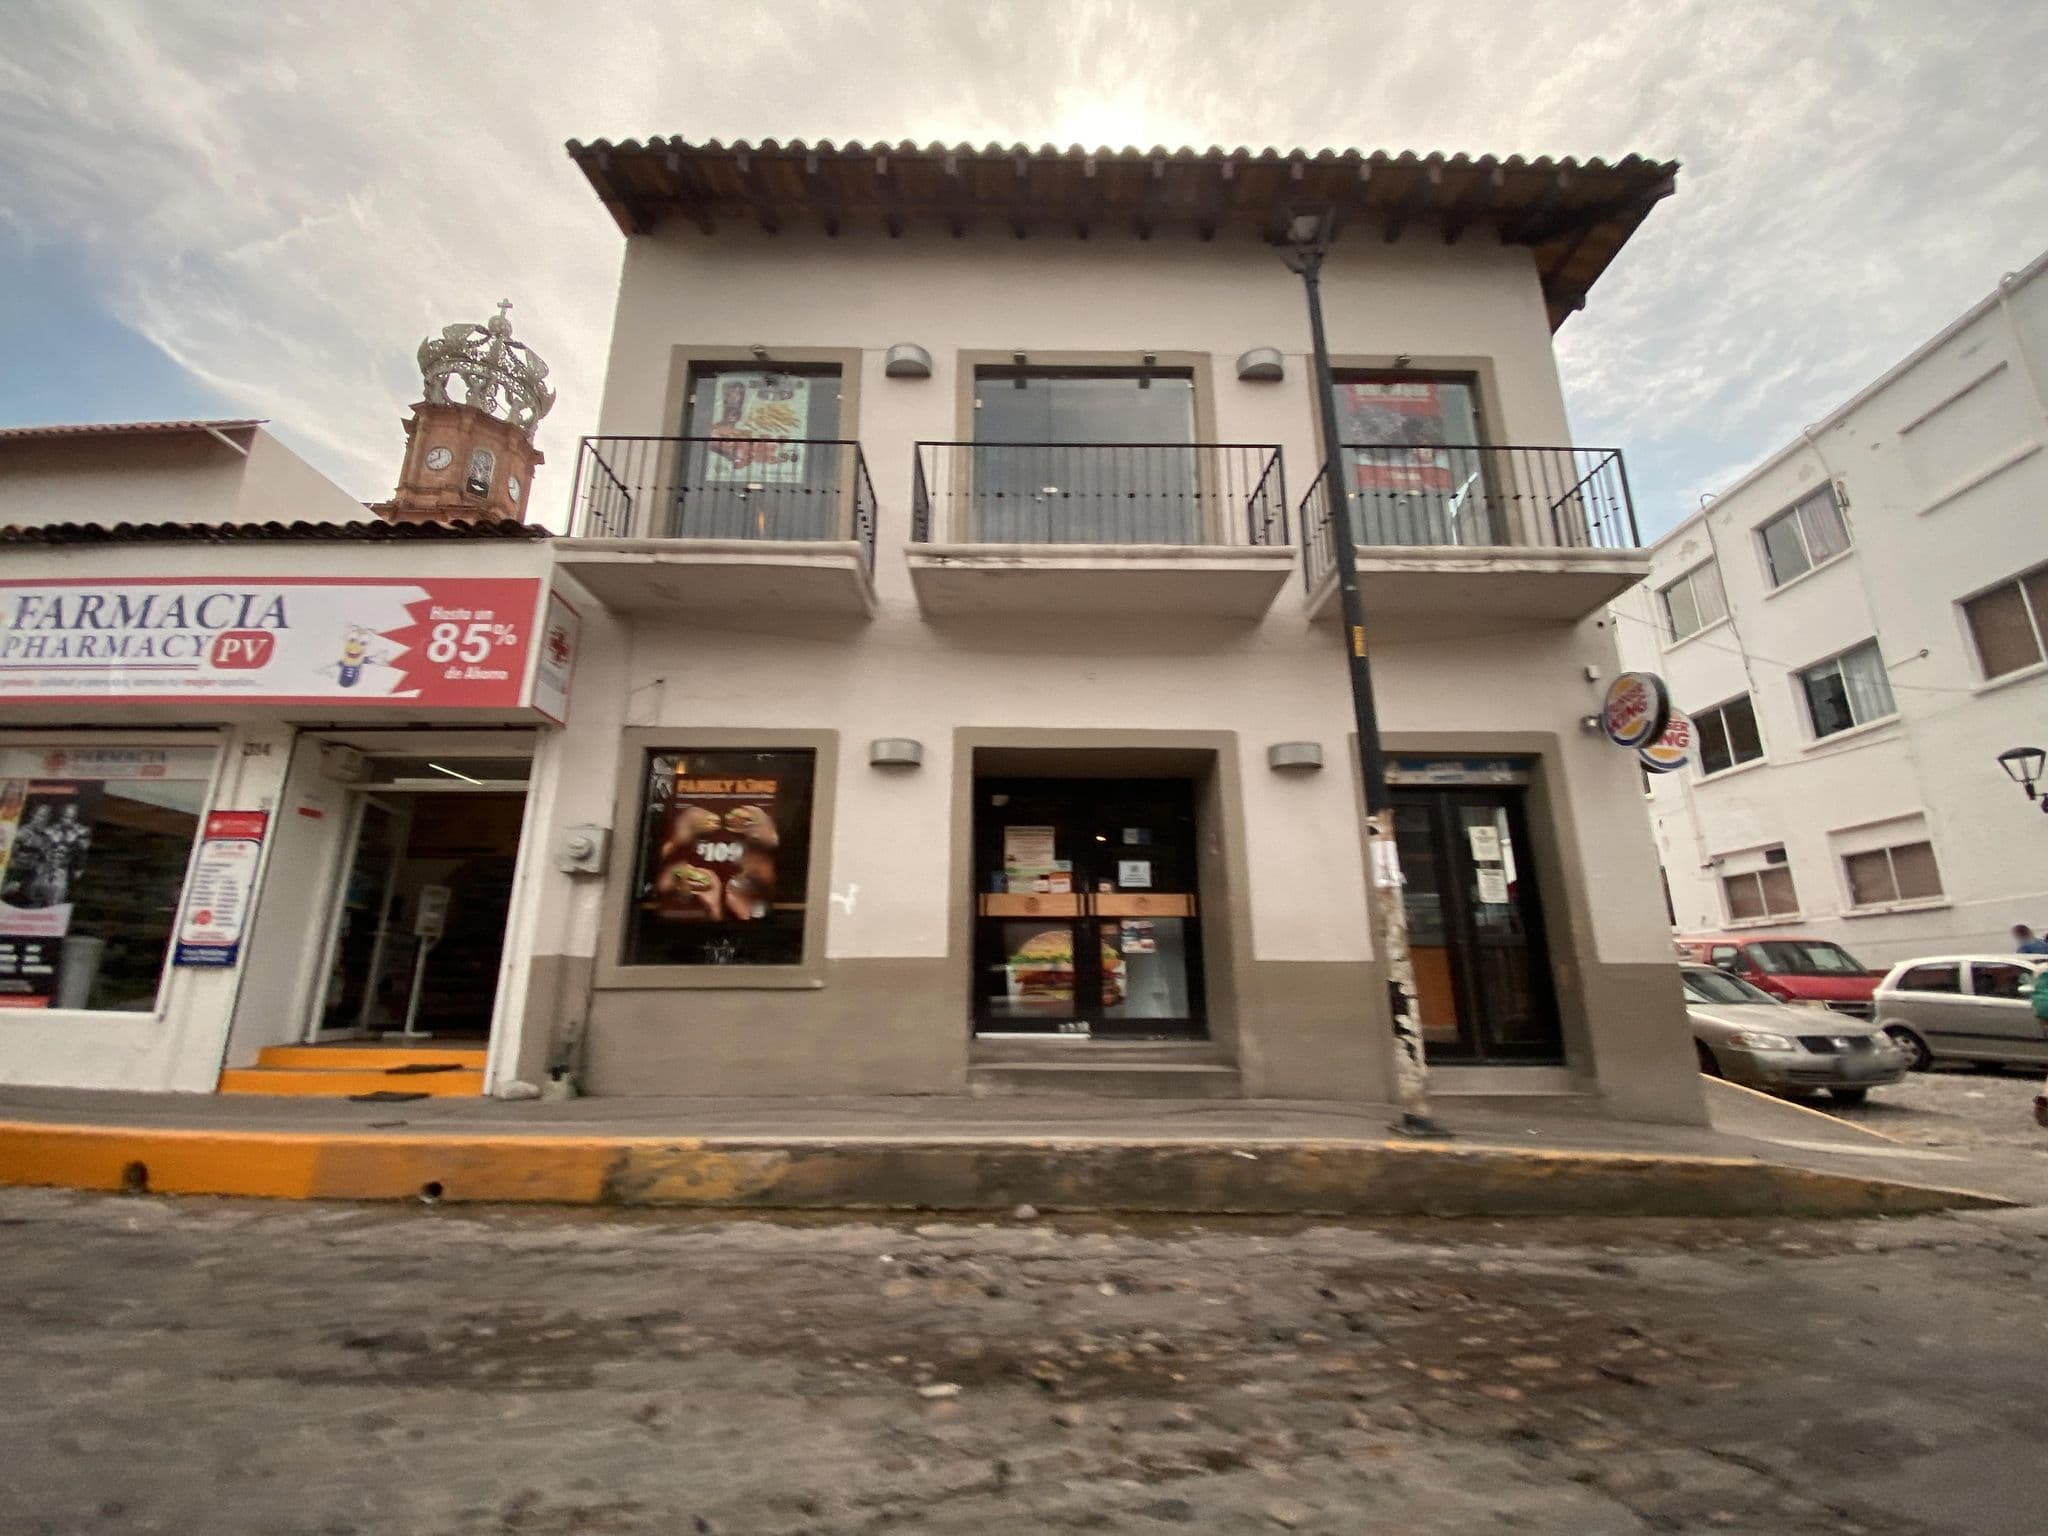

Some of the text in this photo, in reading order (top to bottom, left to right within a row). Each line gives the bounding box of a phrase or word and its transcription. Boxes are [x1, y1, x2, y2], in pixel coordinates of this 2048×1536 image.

[9, 593, 291, 630] FARMACIA
[1, 634, 212, 658] PHARMACY
[215, 638, 269, 662] PV
[427, 622, 518, 663] 85%
[1608, 699, 1648, 732] KING
